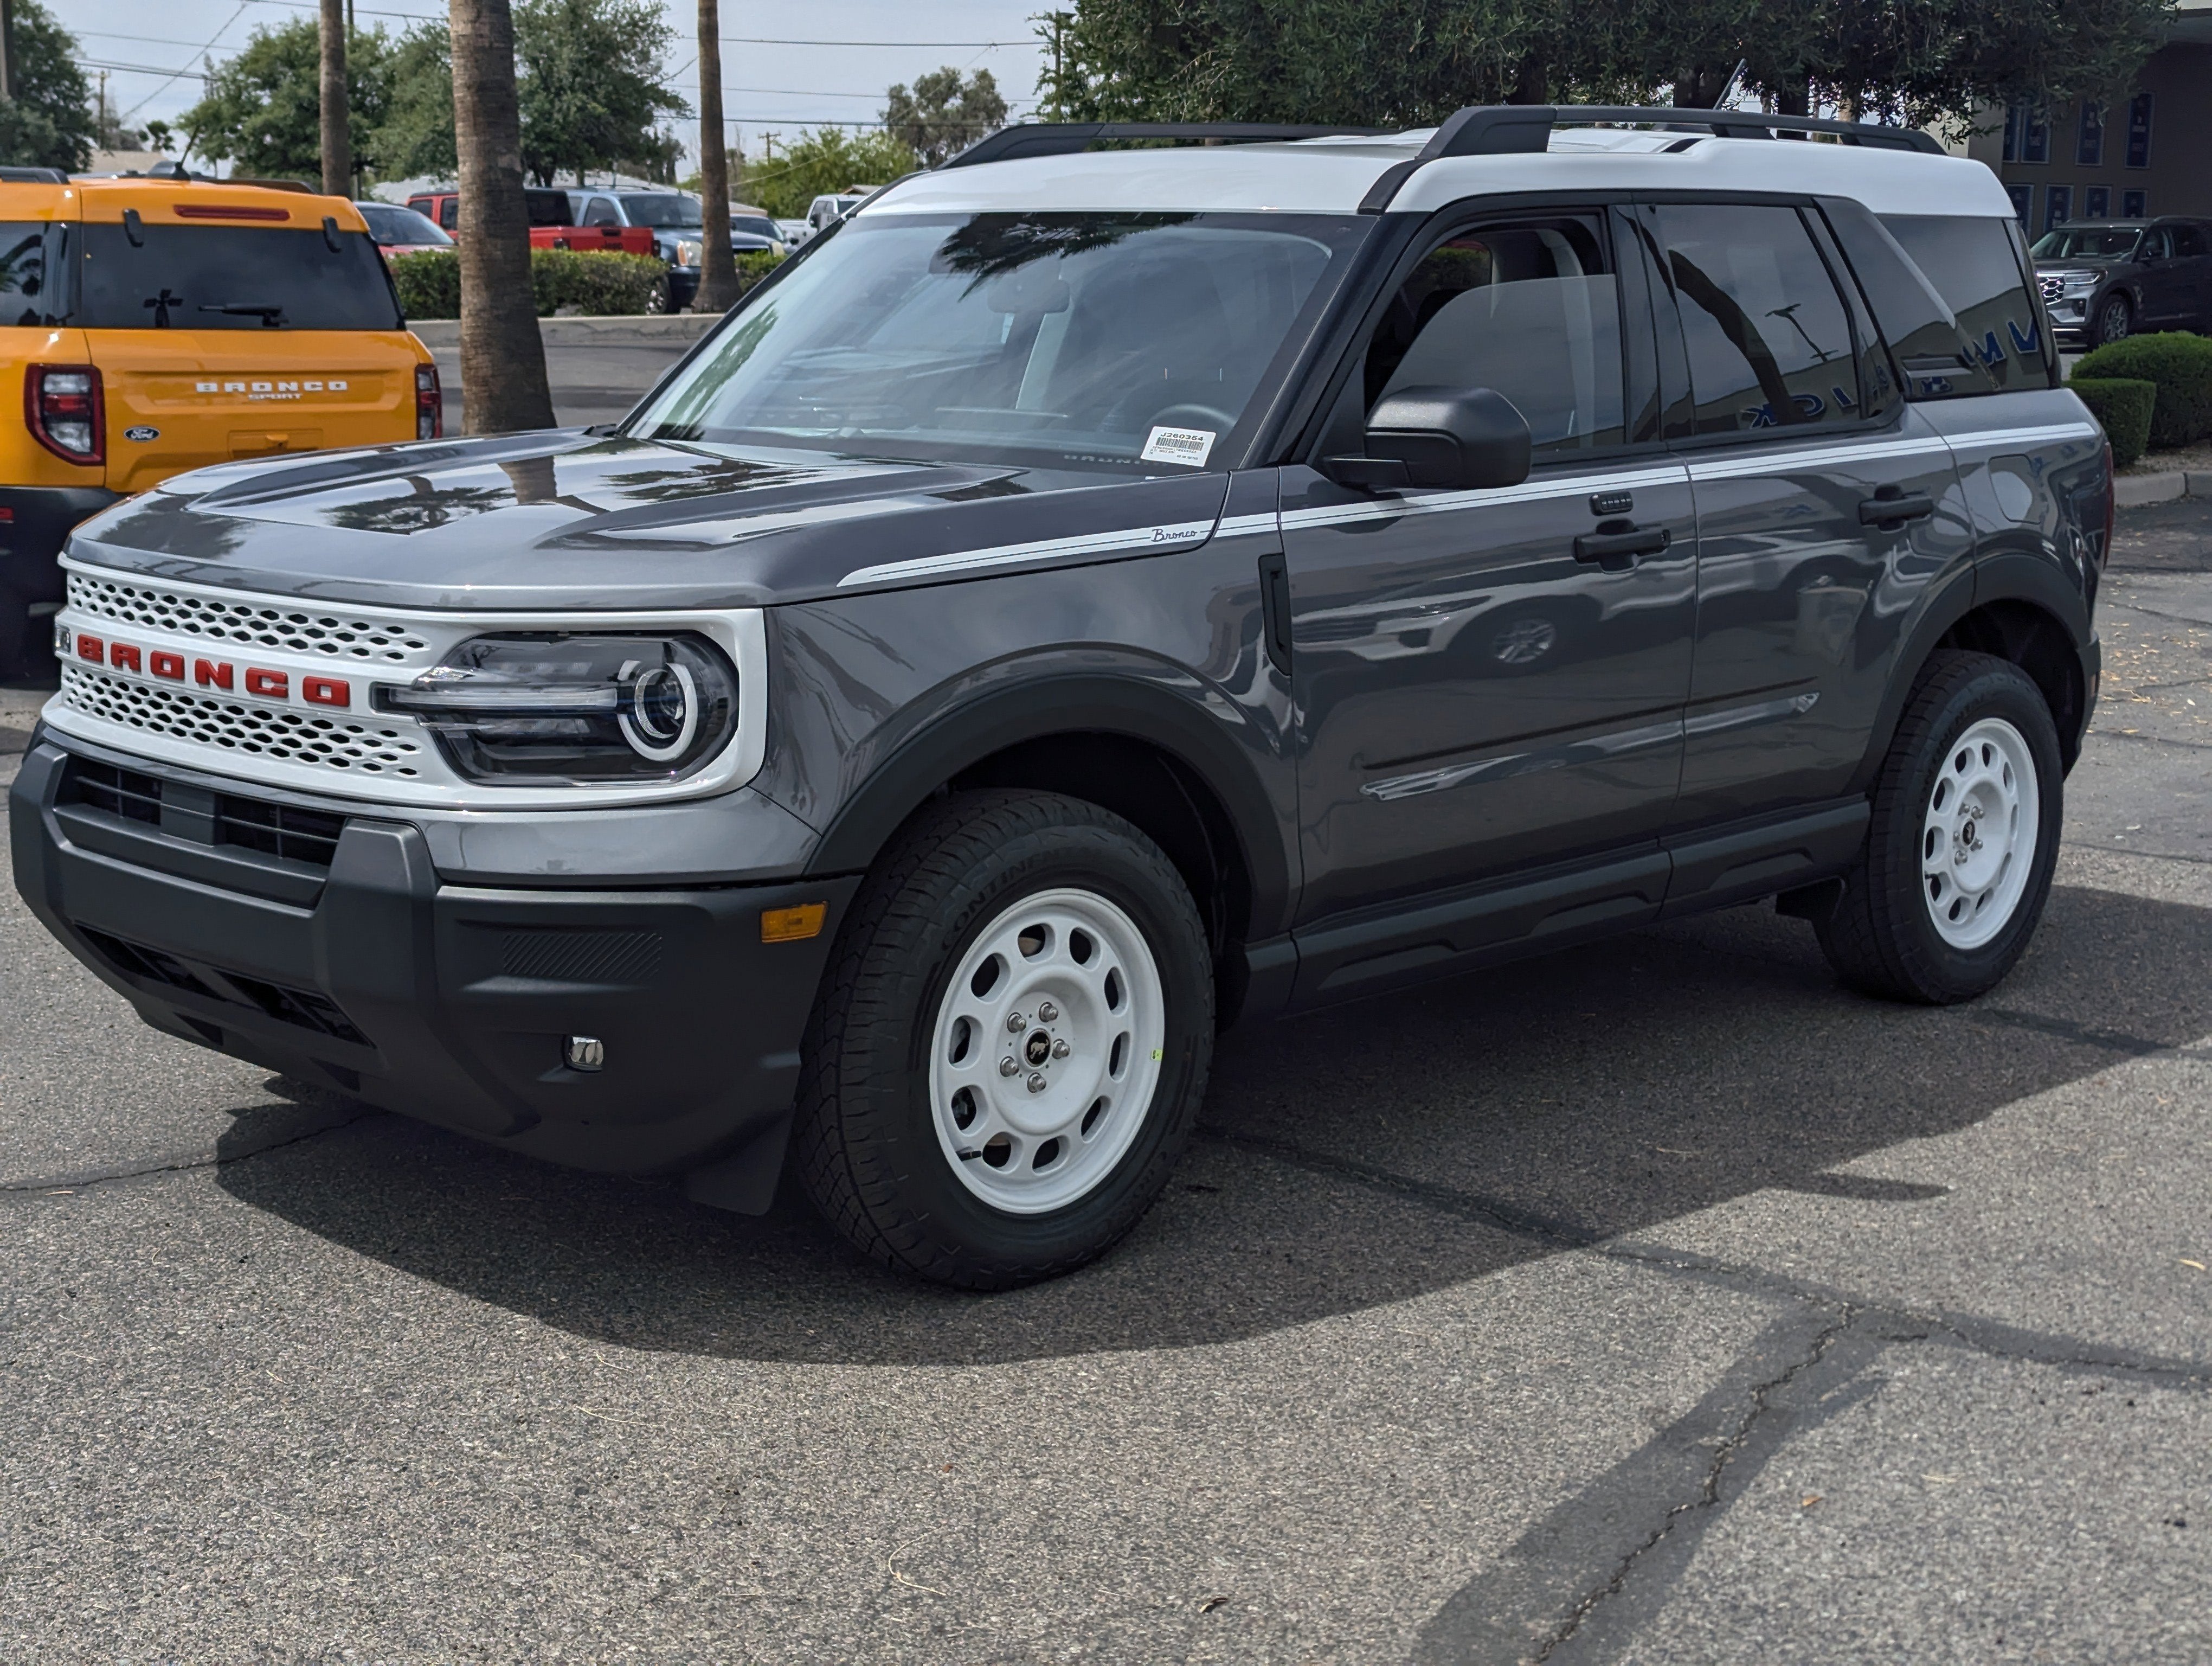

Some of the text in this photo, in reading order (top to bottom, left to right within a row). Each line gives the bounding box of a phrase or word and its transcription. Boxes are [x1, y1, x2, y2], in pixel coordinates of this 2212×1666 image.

[196, 381, 348, 392] BRONCO
[1160, 432, 1204, 441] J260354
[1151, 528, 1198, 542] Bronco
[78, 634, 351, 707] BRONCO
